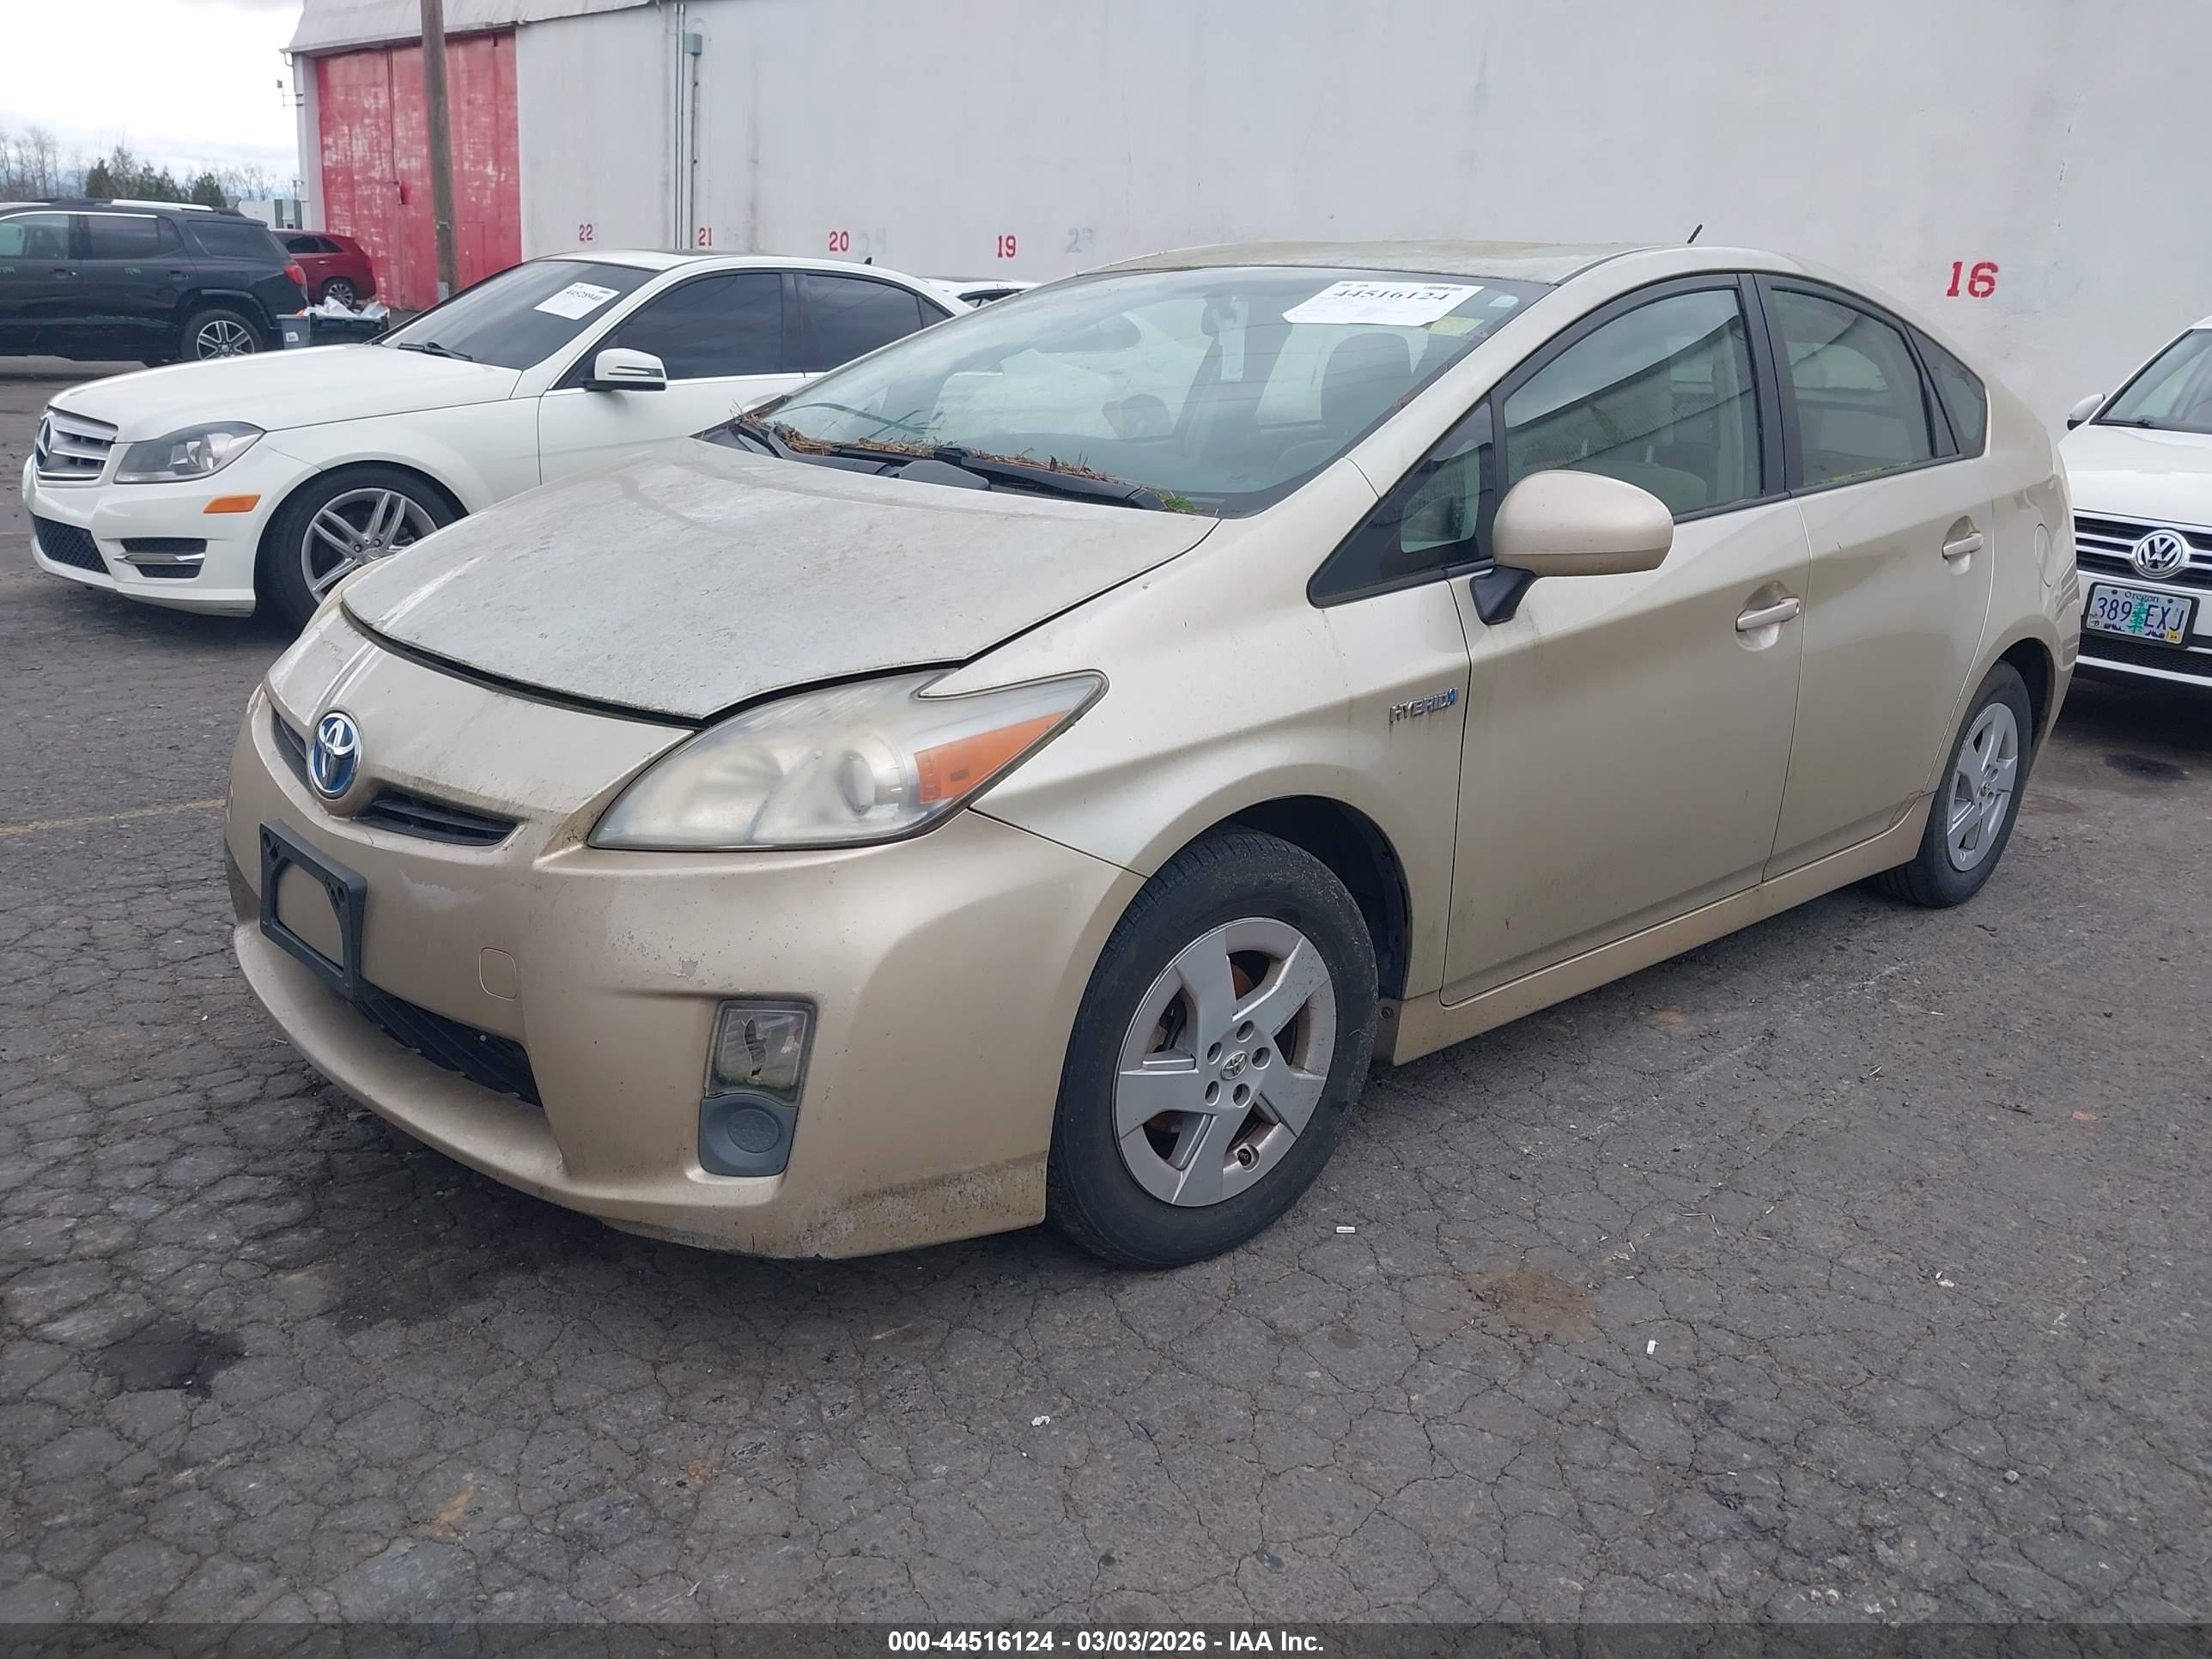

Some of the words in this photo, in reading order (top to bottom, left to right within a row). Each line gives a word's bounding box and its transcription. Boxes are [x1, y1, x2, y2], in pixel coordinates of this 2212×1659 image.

[579, 223, 593, 241] 22
[698, 228, 713, 246] 21
[829, 231, 850, 252] 20
[997, 235, 1017, 258] 19
[1946, 261, 1999, 298] 16
[1334, 289, 1450, 301] 44516124
[2124, 591, 2160, 604] Oregon
[2097, 596, 2133, 623] 389
[2144, 604, 2185, 632] EXJ
[1389, 690, 1449, 722] HYBRID
